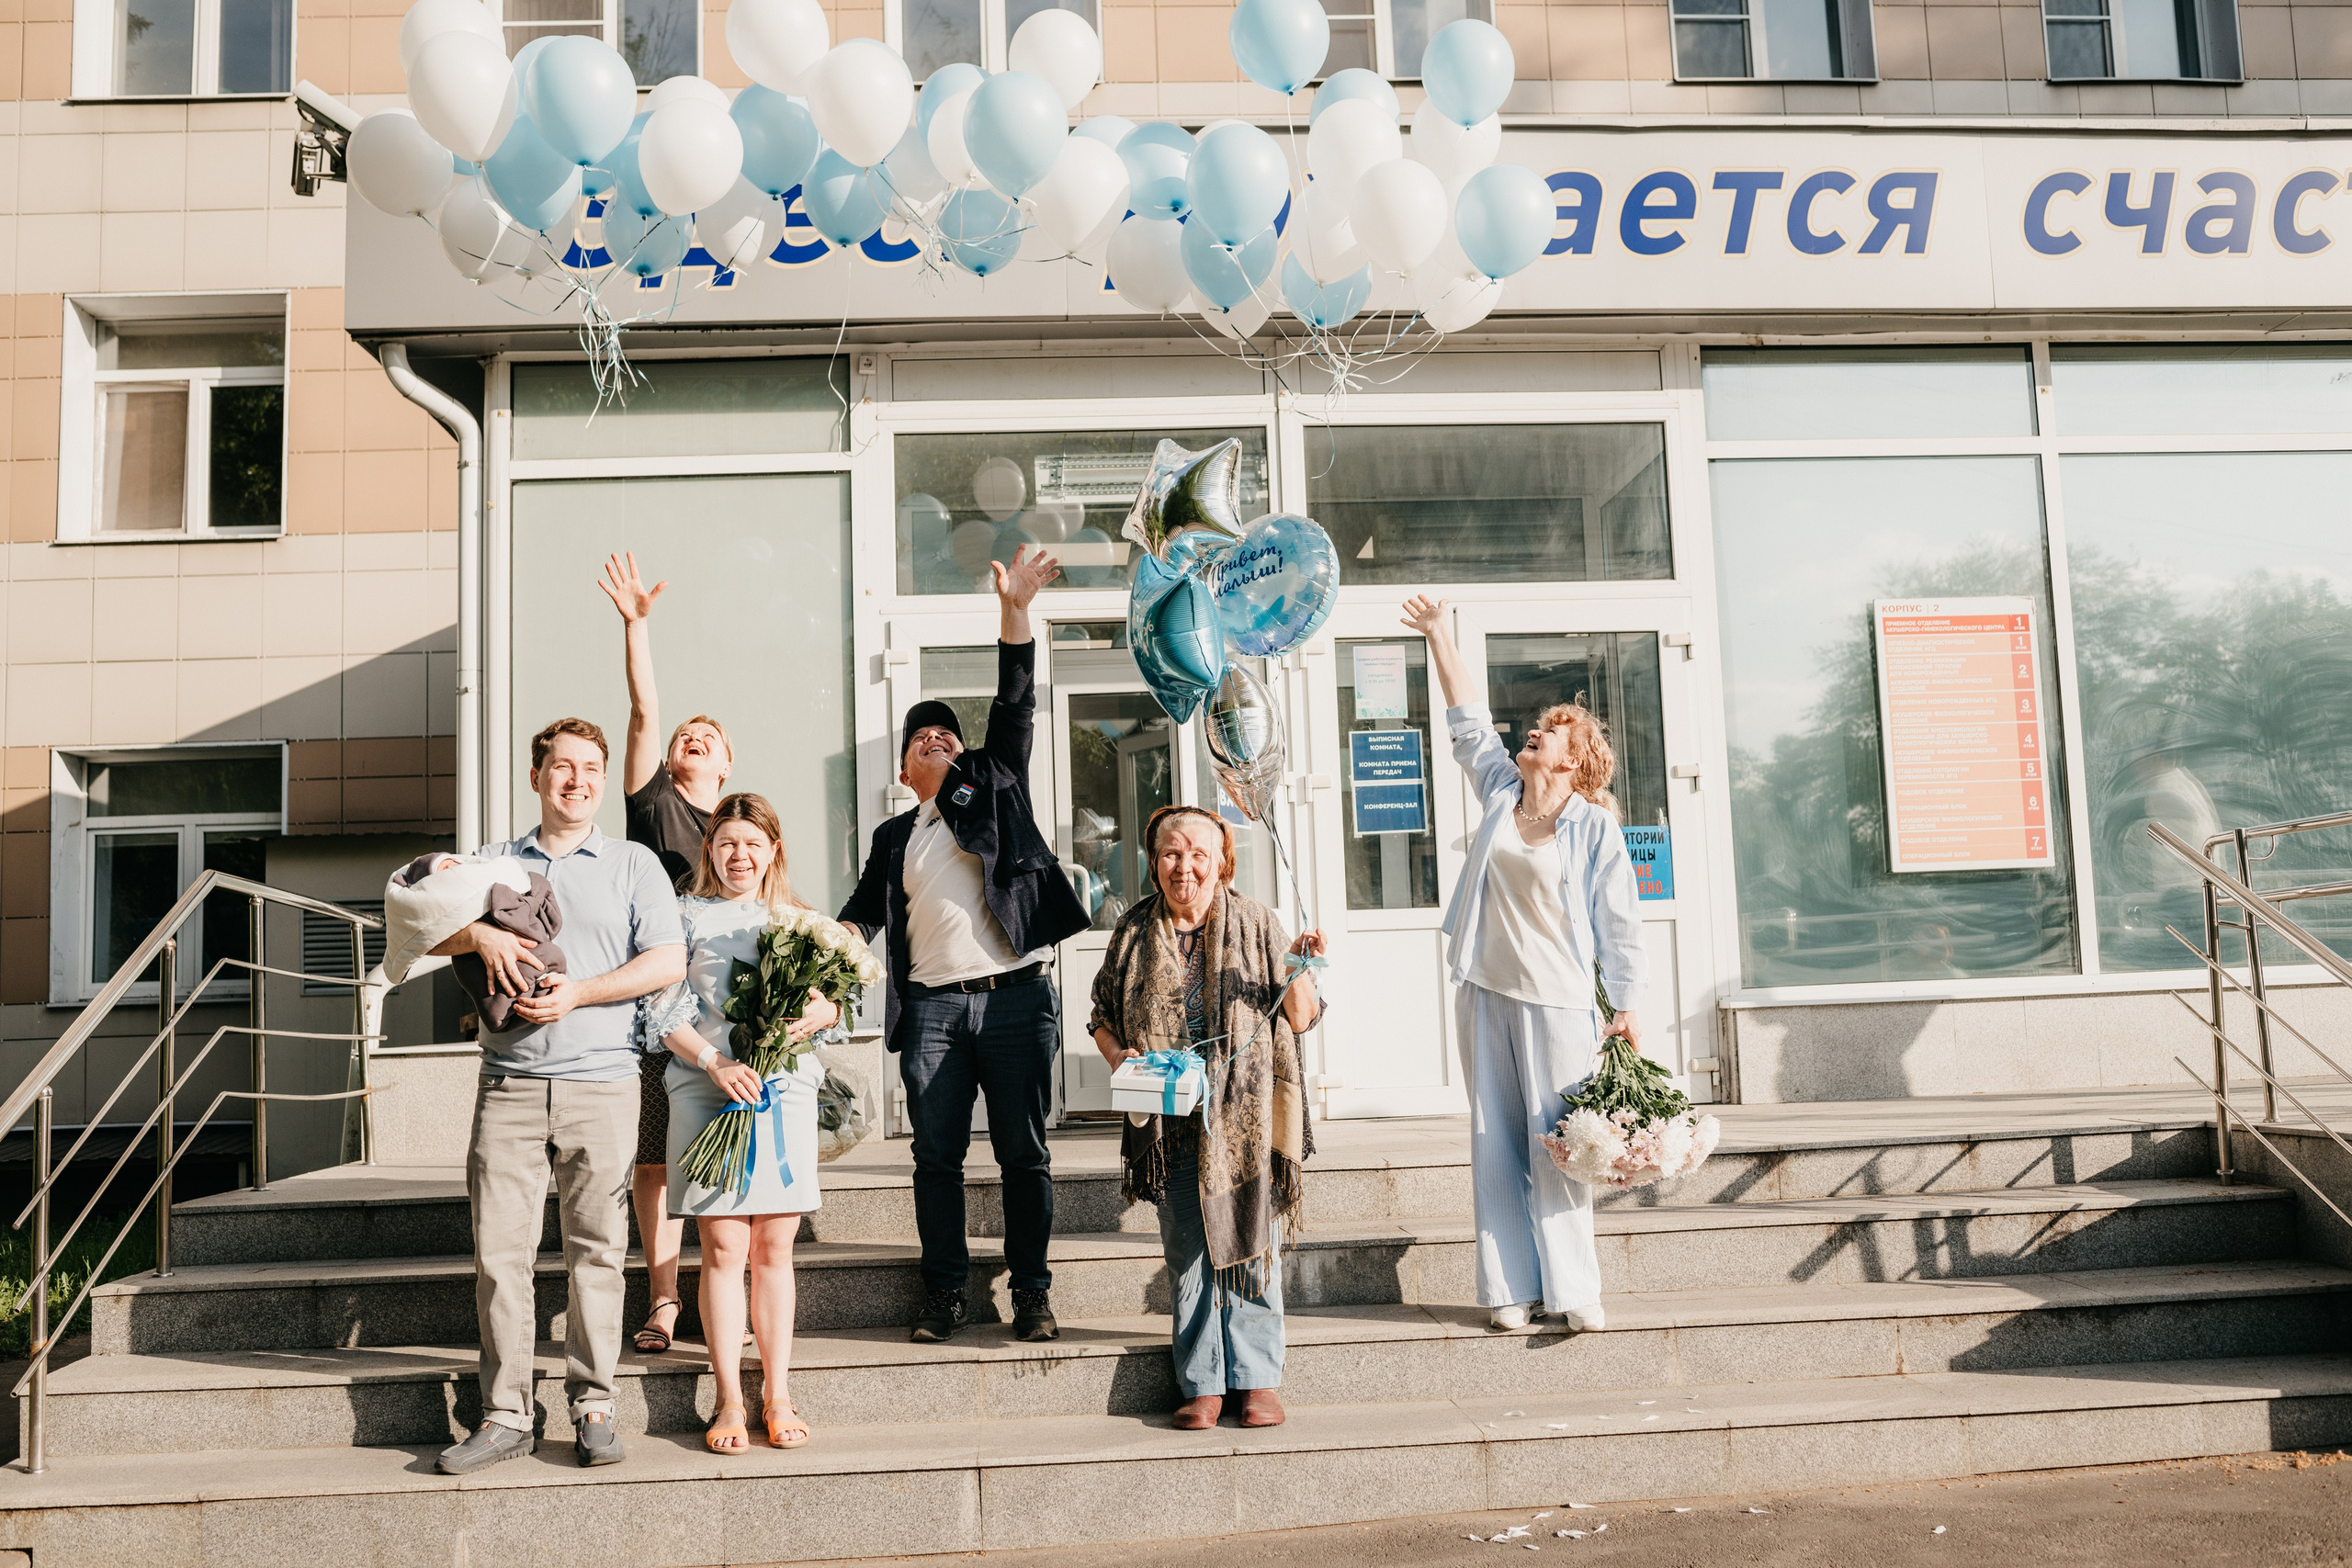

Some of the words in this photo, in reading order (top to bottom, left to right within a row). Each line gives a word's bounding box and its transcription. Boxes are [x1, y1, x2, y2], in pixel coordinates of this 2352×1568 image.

[2019, 166, 2352, 259] счас
[1211, 546, 1282, 588] Привет,
[1214, 557, 1283, 602] малыш!
[1882, 604, 1922, 613] КОРПУС
[2016, 615, 2021, 626] 1
[2017, 636, 2023, 645] 1
[2018, 664, 2027, 674] 2
[2020, 698, 2030, 709] 3
[2023, 733, 2032, 743] 4
[2026, 762, 2034, 773] 5
[2029, 796, 2037, 806] 6
[1623, 831, 1664, 844] ИТОРИИ
[2031, 836, 2040, 846] 7
[1627, 848, 1656, 863] ИЦЫ
[1633, 864, 1652, 878] ИЕ
[1639, 880, 1662, 894] ЕНО
